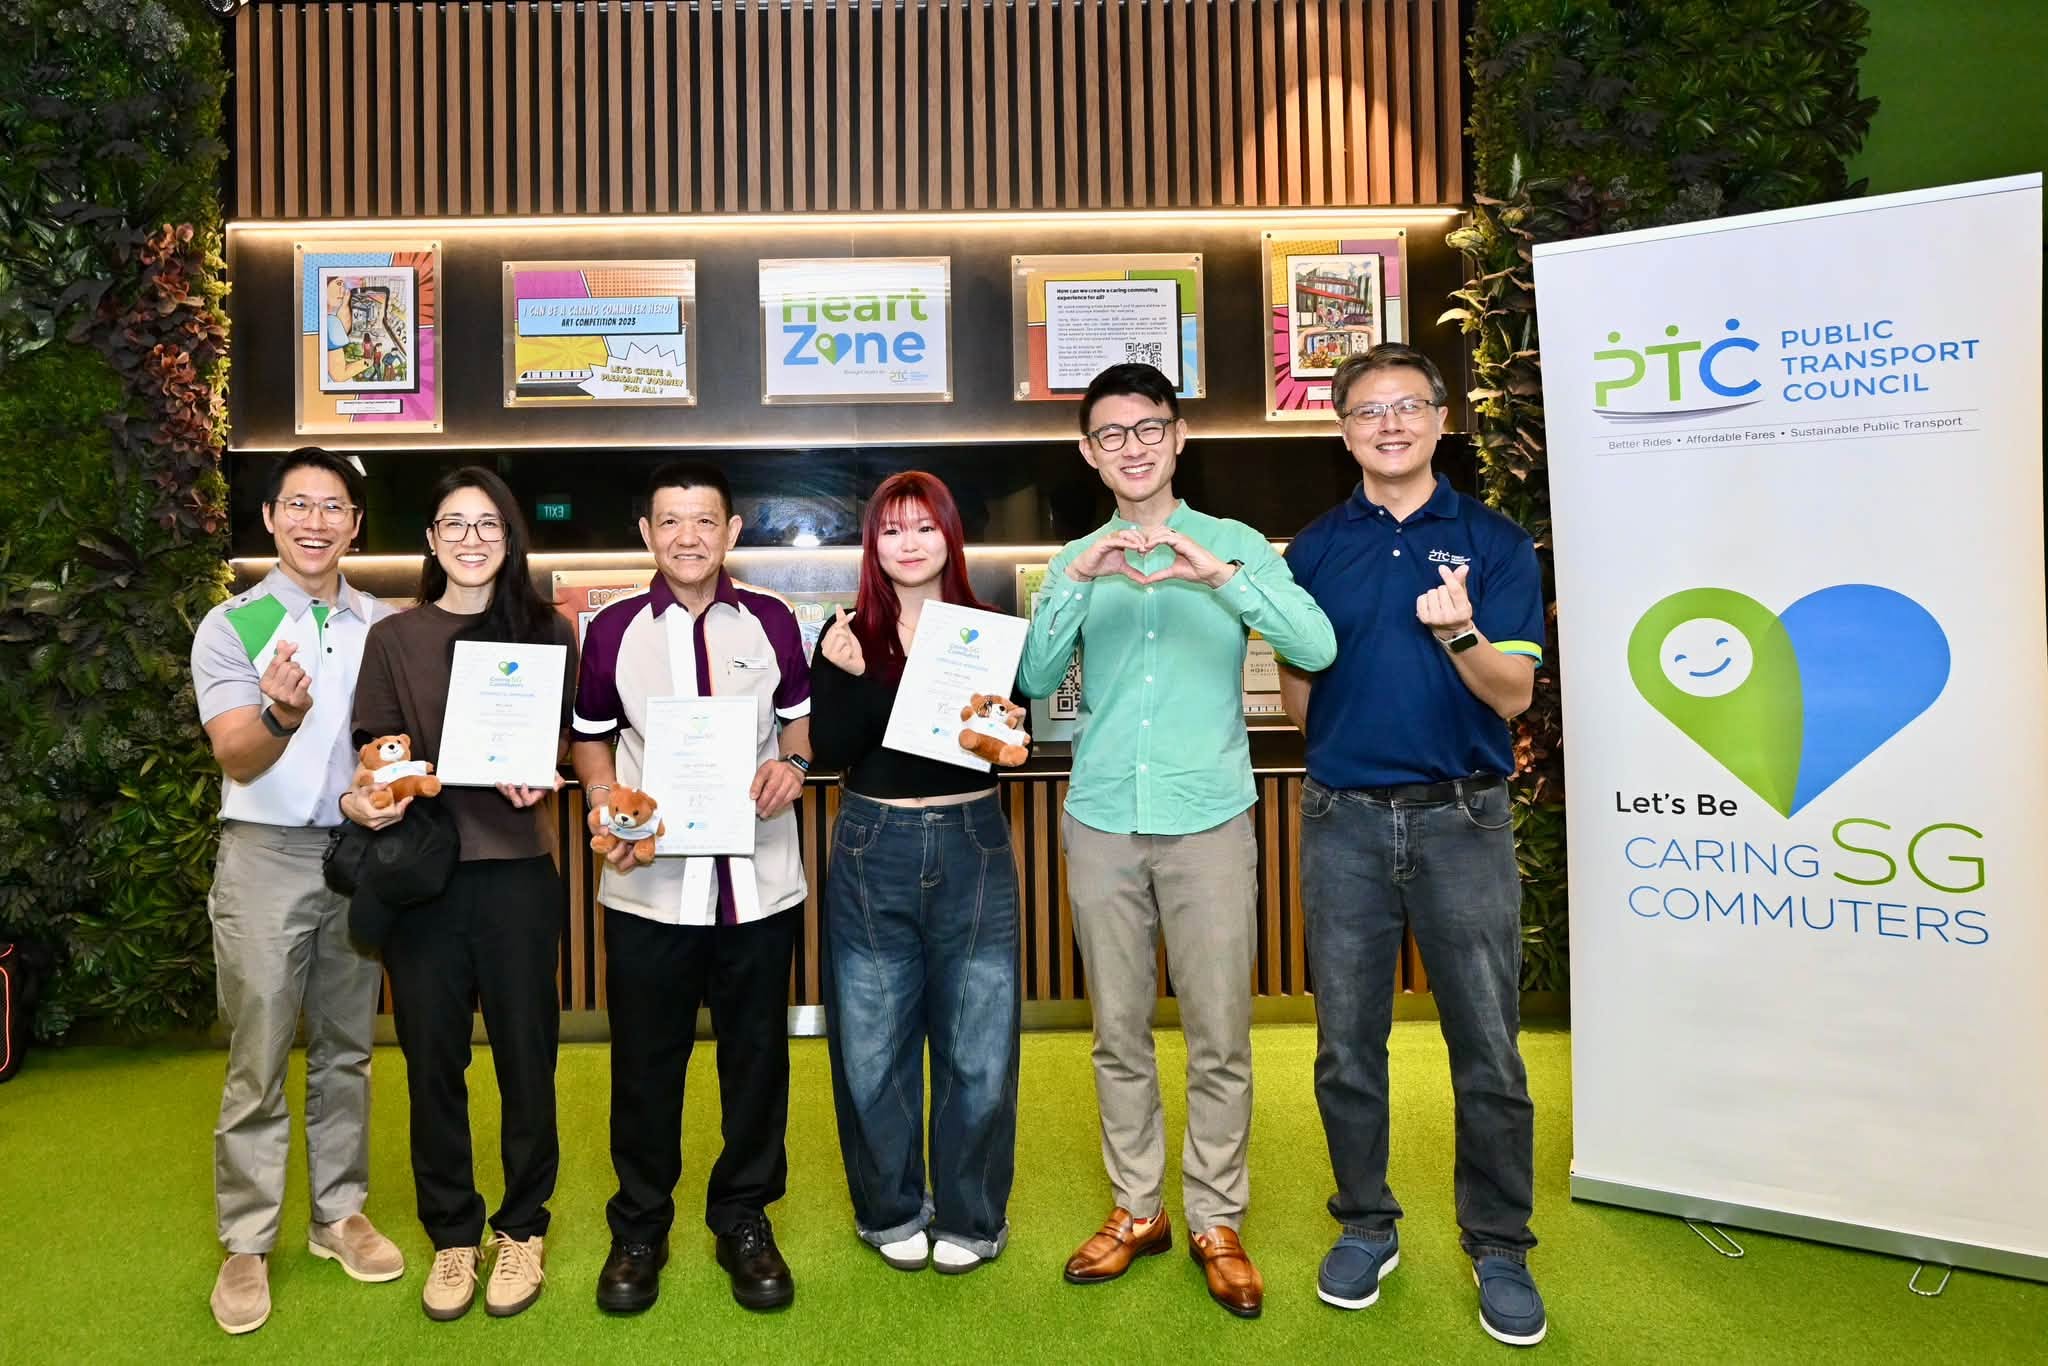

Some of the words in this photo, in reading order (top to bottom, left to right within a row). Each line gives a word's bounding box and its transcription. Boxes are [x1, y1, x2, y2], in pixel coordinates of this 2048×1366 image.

[529, 305, 546, 316] CAN
[548, 304, 560, 316] BE
[560, 305, 566, 315] A
[568, 304, 599, 316] CARING
[601, 303, 647, 315] COMMUTER
[648, 303, 674, 315] HERO!
[782, 288, 928, 322] Heart
[561, 318, 574, 327] ART
[575, 318, 617, 327] COMPETITION
[618, 317, 636, 326] 2023
[1781, 319, 1894, 349] PUBLIC
[1593, 319, 1762, 407] PTC
[1781, 339, 1980, 375] TRANSPORT
[601, 374, 643, 385] PLEASANT
[646, 376, 683, 387] JOURNEY
[635, 367, 664, 377] CREATE
[623, 383, 641, 393] FOR
[1783, 373, 1929, 402] COUNCIL
[1608, 440, 1639, 449] Better
[1642, 437, 1672, 448] Rides
[1686, 433, 1742, 445] Affordable
[1745, 430, 1776, 441] Fares
[1790, 424, 1860, 438] Sustainable
[1863, 420, 1900, 432] Public
[1903, 416, 1963, 430] Transport
[1697, 794, 1738, 816] Be
[1625, 836, 1819, 878] CARING
[1832, 817, 1985, 894] SG
[1628, 885, 1989, 945] COMMUTERS
